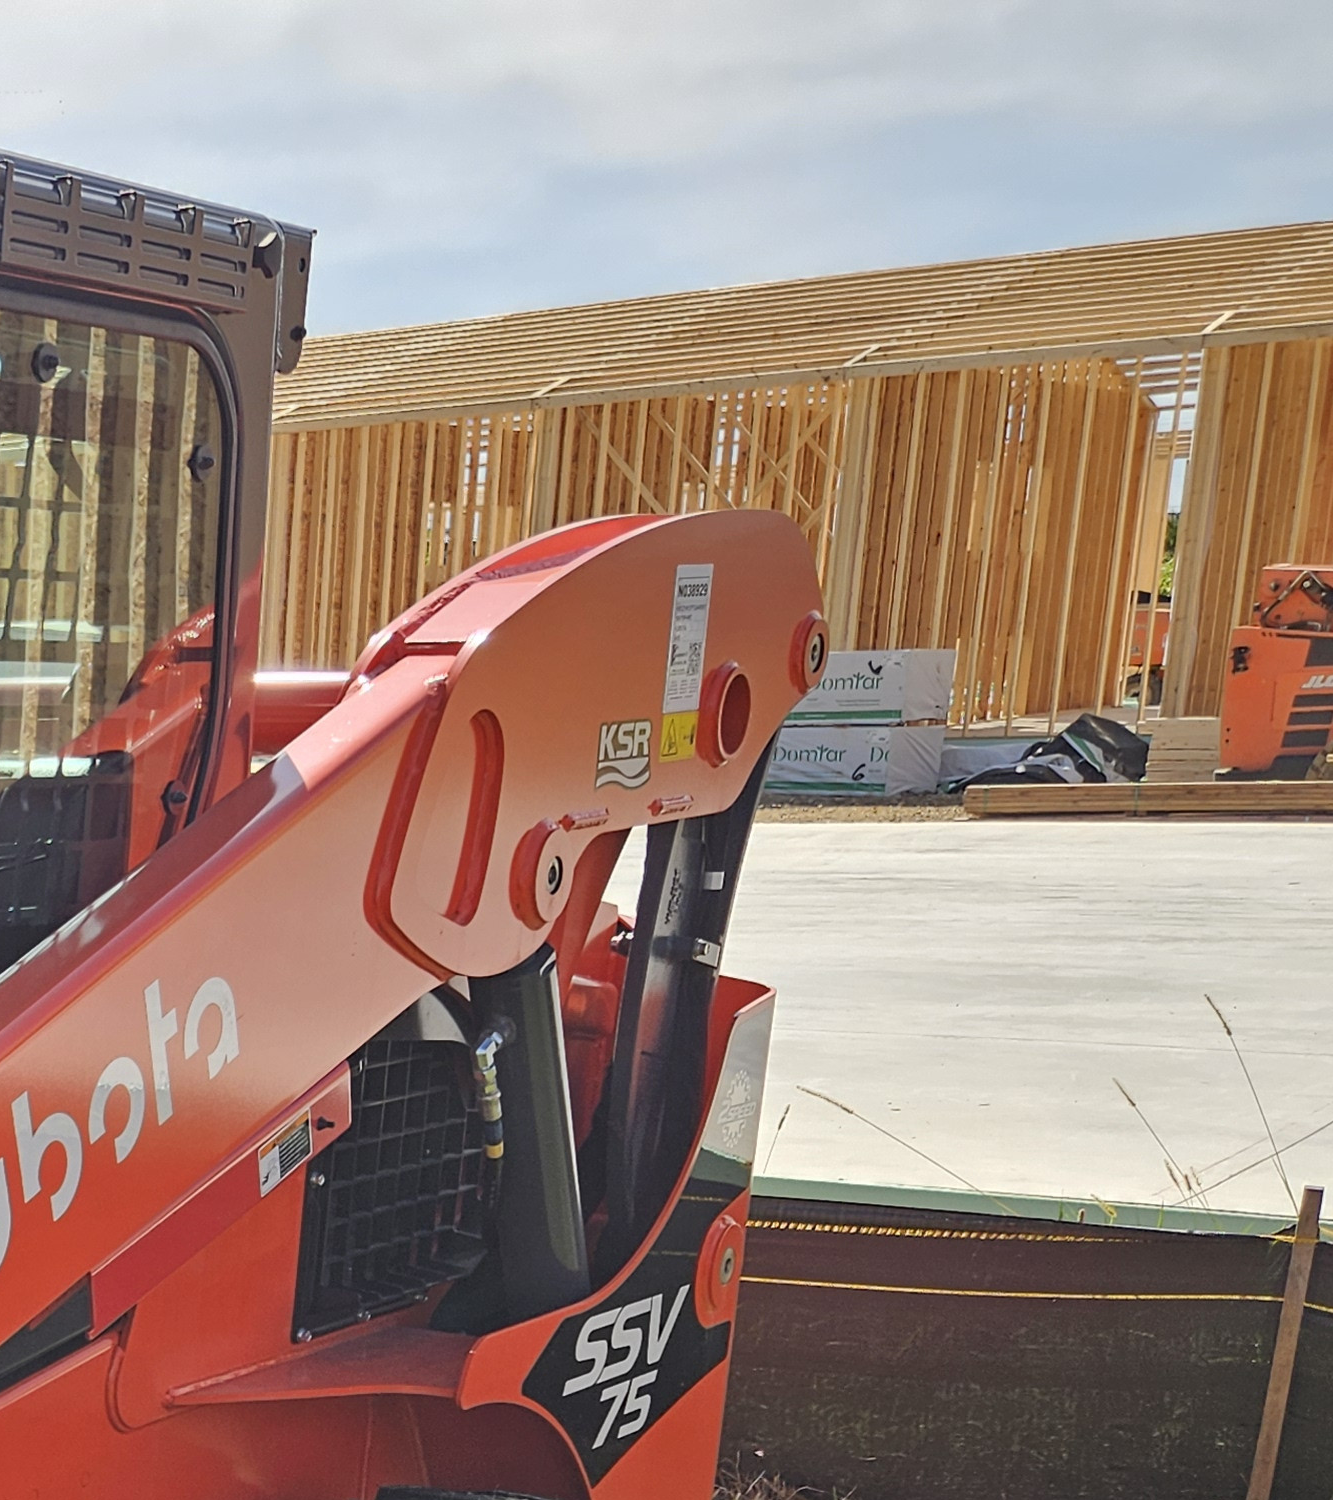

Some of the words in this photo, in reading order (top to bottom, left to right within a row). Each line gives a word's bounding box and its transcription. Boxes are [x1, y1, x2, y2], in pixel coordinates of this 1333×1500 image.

[815, 672, 884, 692] omtar
[598, 720, 652, 761] KSR
[773, 744, 847, 762] Domtar
[851, 763, 866, 781] 6
[562, 1284, 691, 1397] SSV
[592, 1370, 658, 1450] 75
